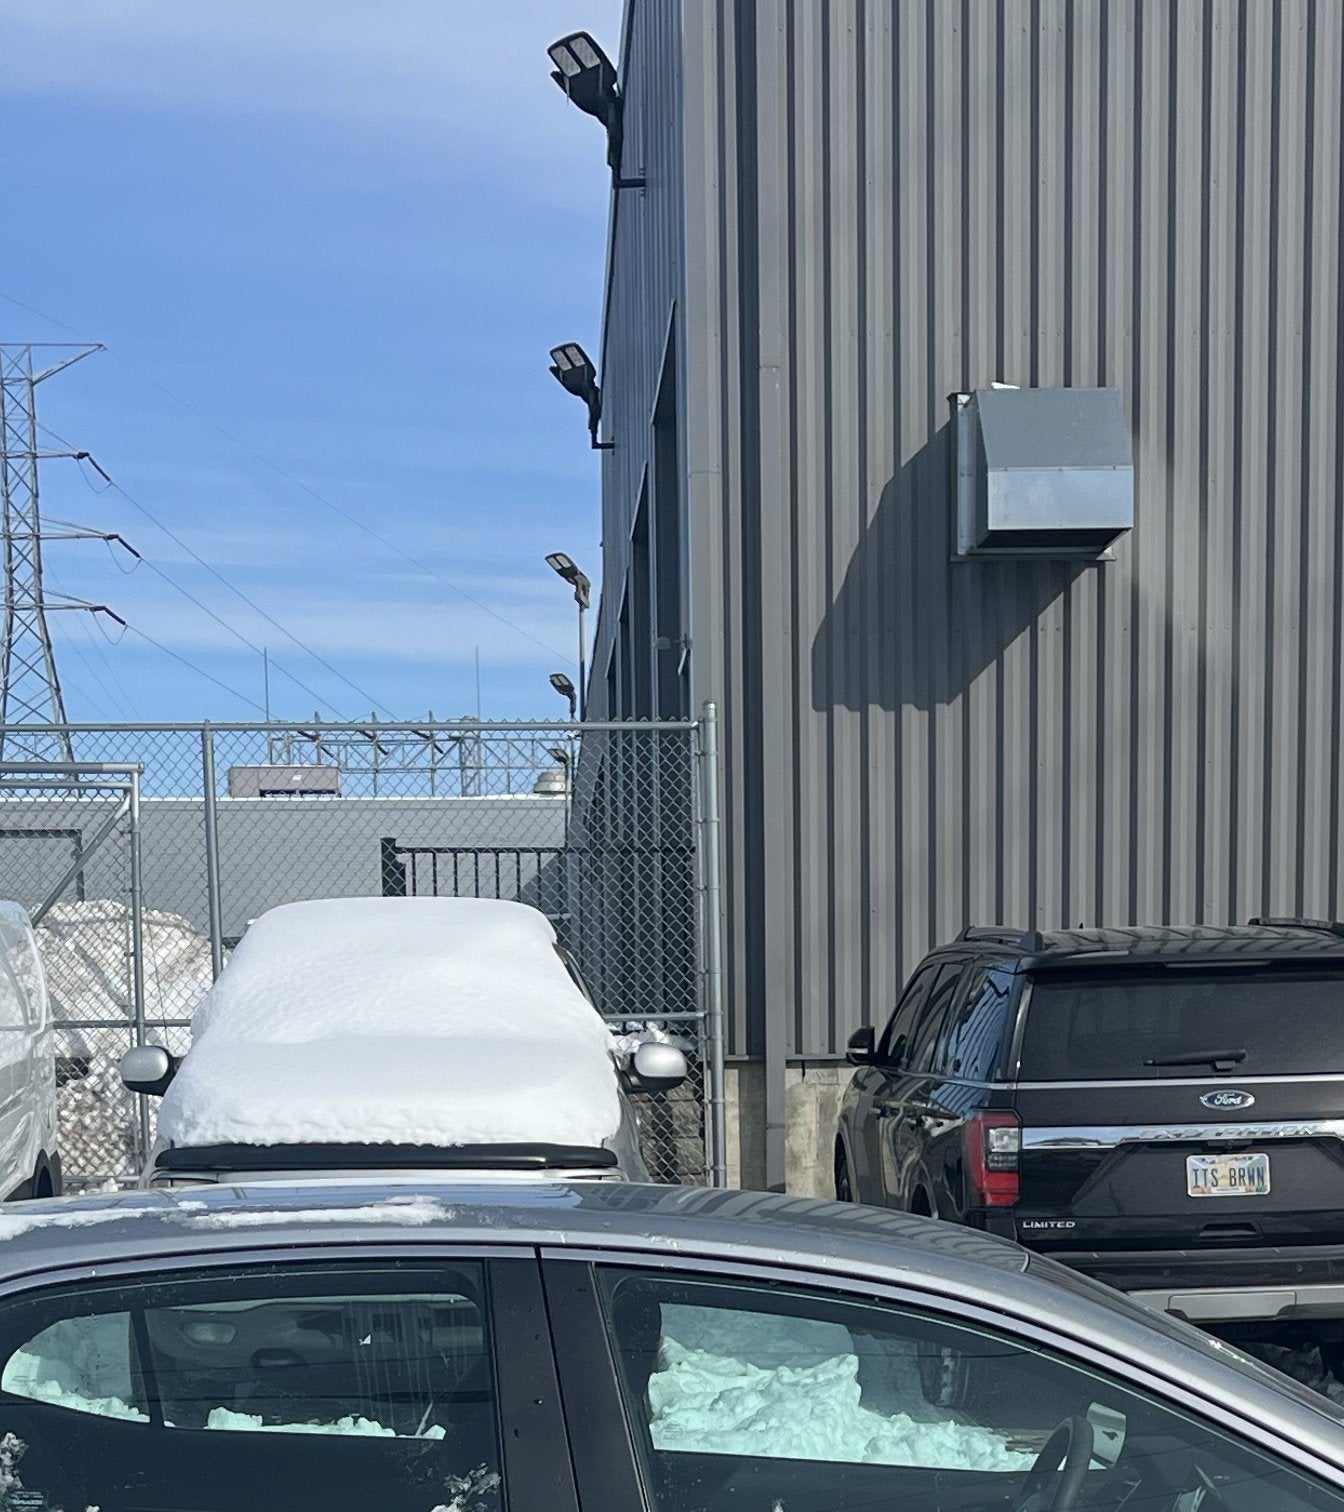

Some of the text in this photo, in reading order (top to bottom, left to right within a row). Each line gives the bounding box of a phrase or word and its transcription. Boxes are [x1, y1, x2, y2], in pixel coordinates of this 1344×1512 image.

[1192, 1166, 1265, 1188] ITS BRWN
[1022, 1220, 1076, 1229] LIMITED
